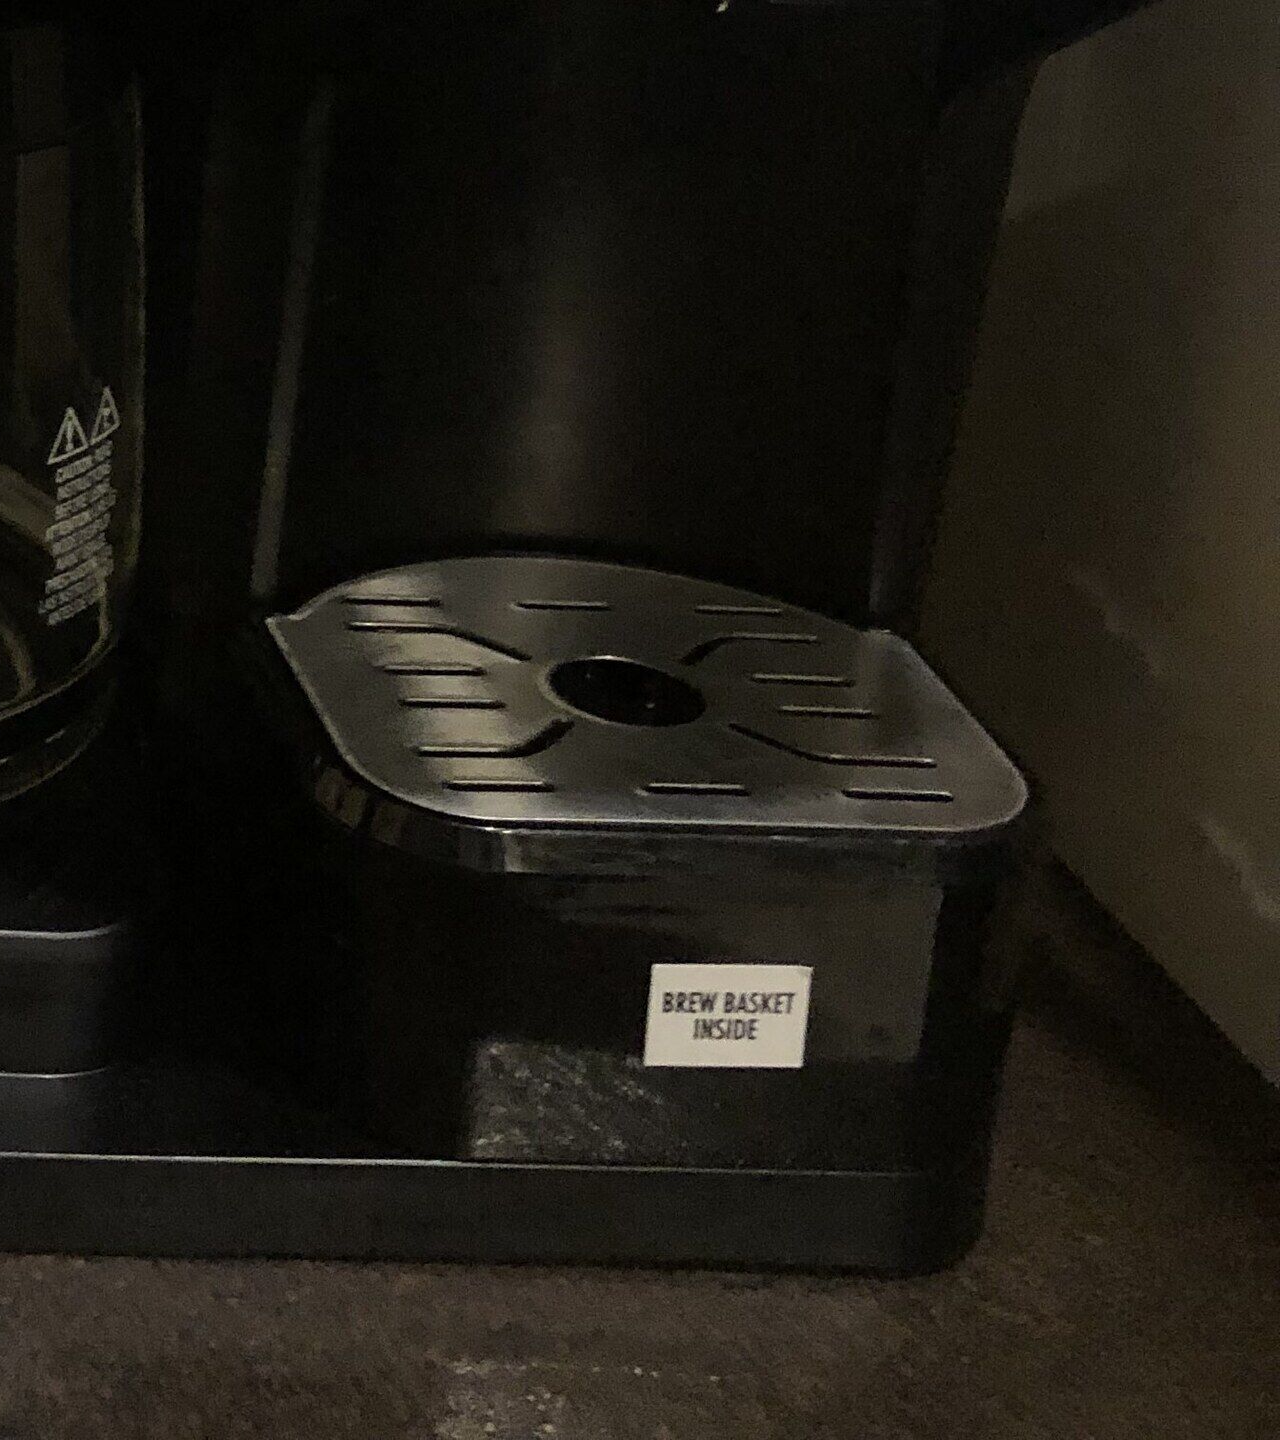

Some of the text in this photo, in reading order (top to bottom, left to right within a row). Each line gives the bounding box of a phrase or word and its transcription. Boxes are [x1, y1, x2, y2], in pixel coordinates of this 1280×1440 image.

[662, 991, 795, 1014] BREW BASKET
[692, 1019, 760, 1041] INSIDE
